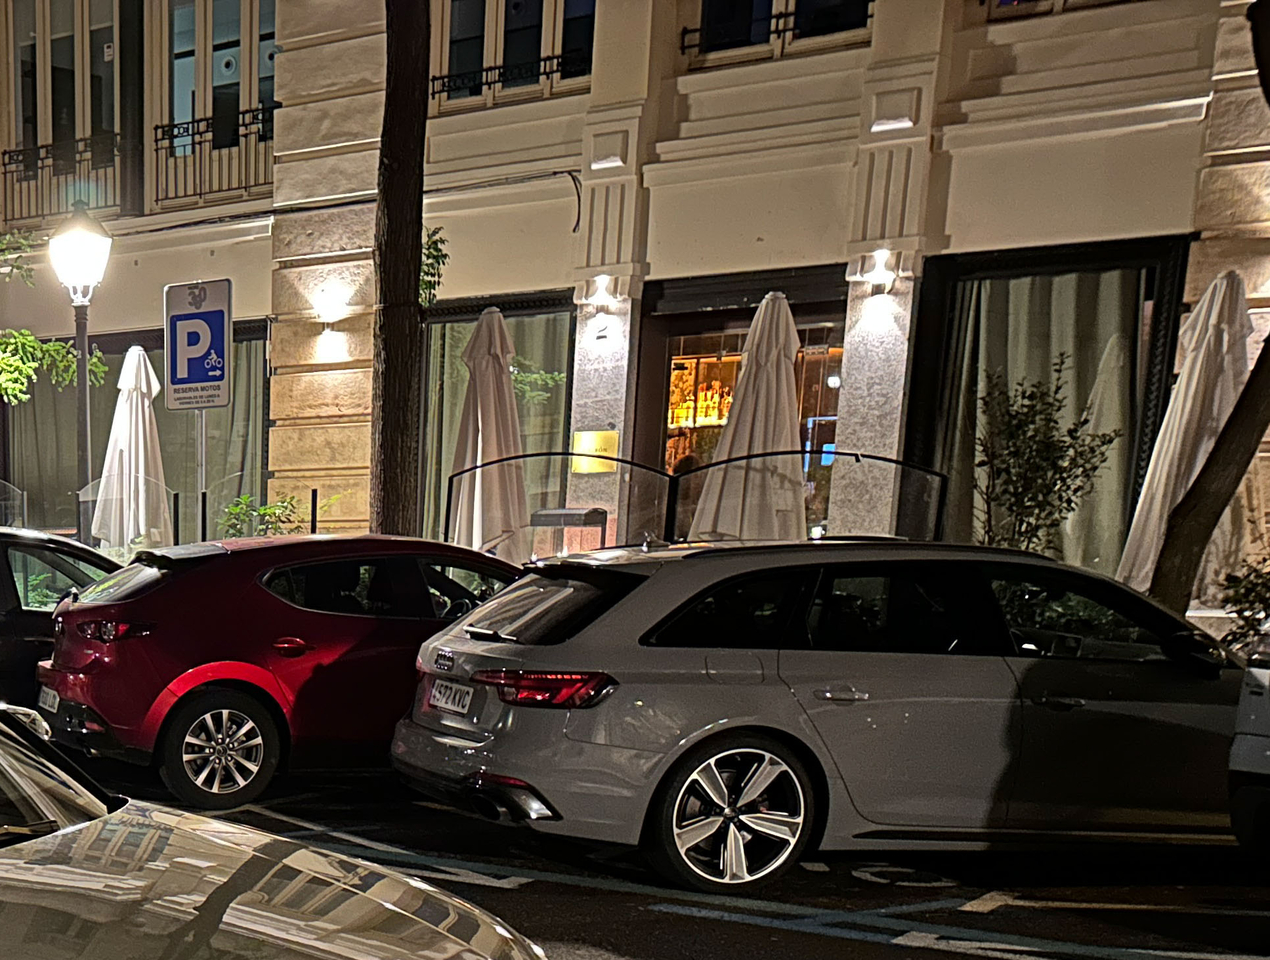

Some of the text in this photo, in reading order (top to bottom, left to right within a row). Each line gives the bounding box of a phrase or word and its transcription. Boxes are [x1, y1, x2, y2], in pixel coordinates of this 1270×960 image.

[176, 318, 212, 379] P
[173, 384, 221, 394] RESERVA MOTOS
[451, 687, 470, 709] KVC
